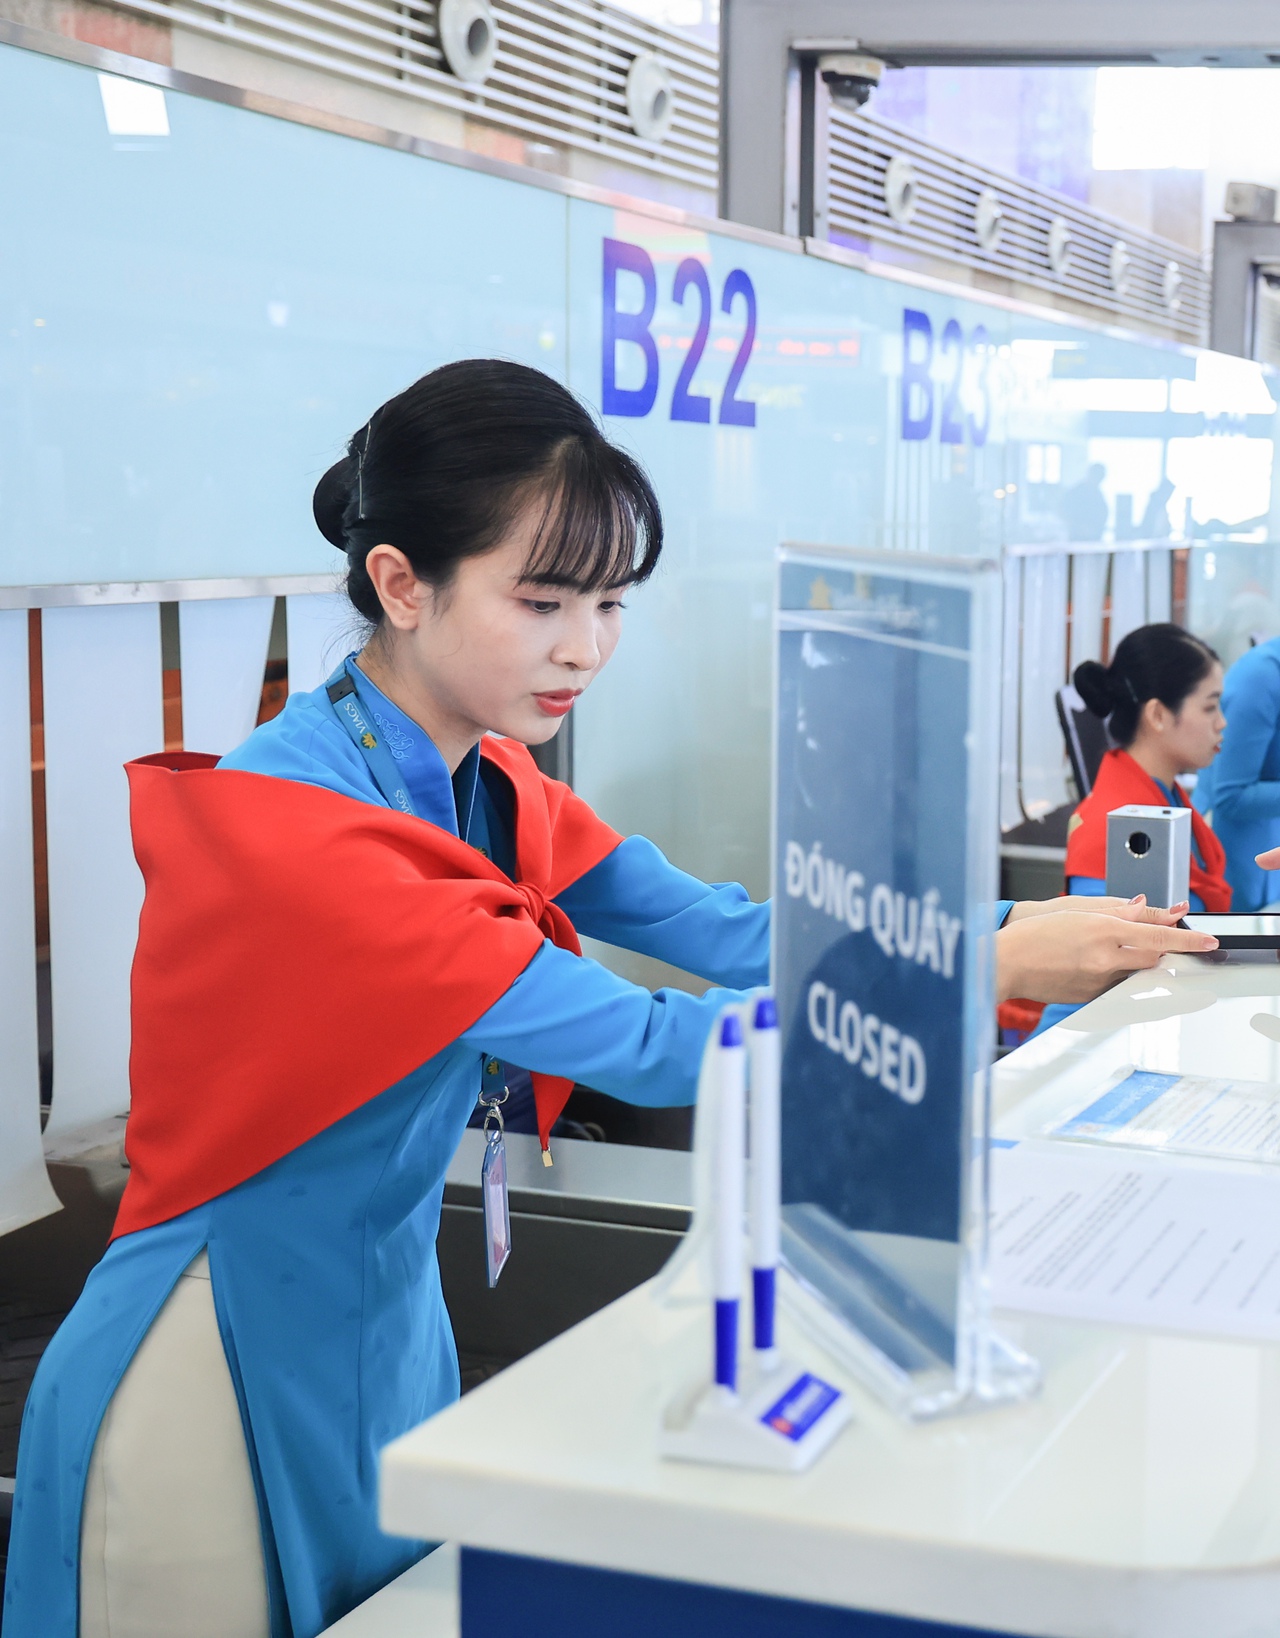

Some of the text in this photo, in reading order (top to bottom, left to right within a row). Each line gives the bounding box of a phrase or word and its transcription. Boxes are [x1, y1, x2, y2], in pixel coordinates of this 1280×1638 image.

[602, 237, 758, 428] B22
[343, 702, 366, 734] VIAGS
[394, 789, 413, 816] IAGS
[785, 840, 866, 932] ĐÓNG
[807, 980, 928, 1106] CLOSED
